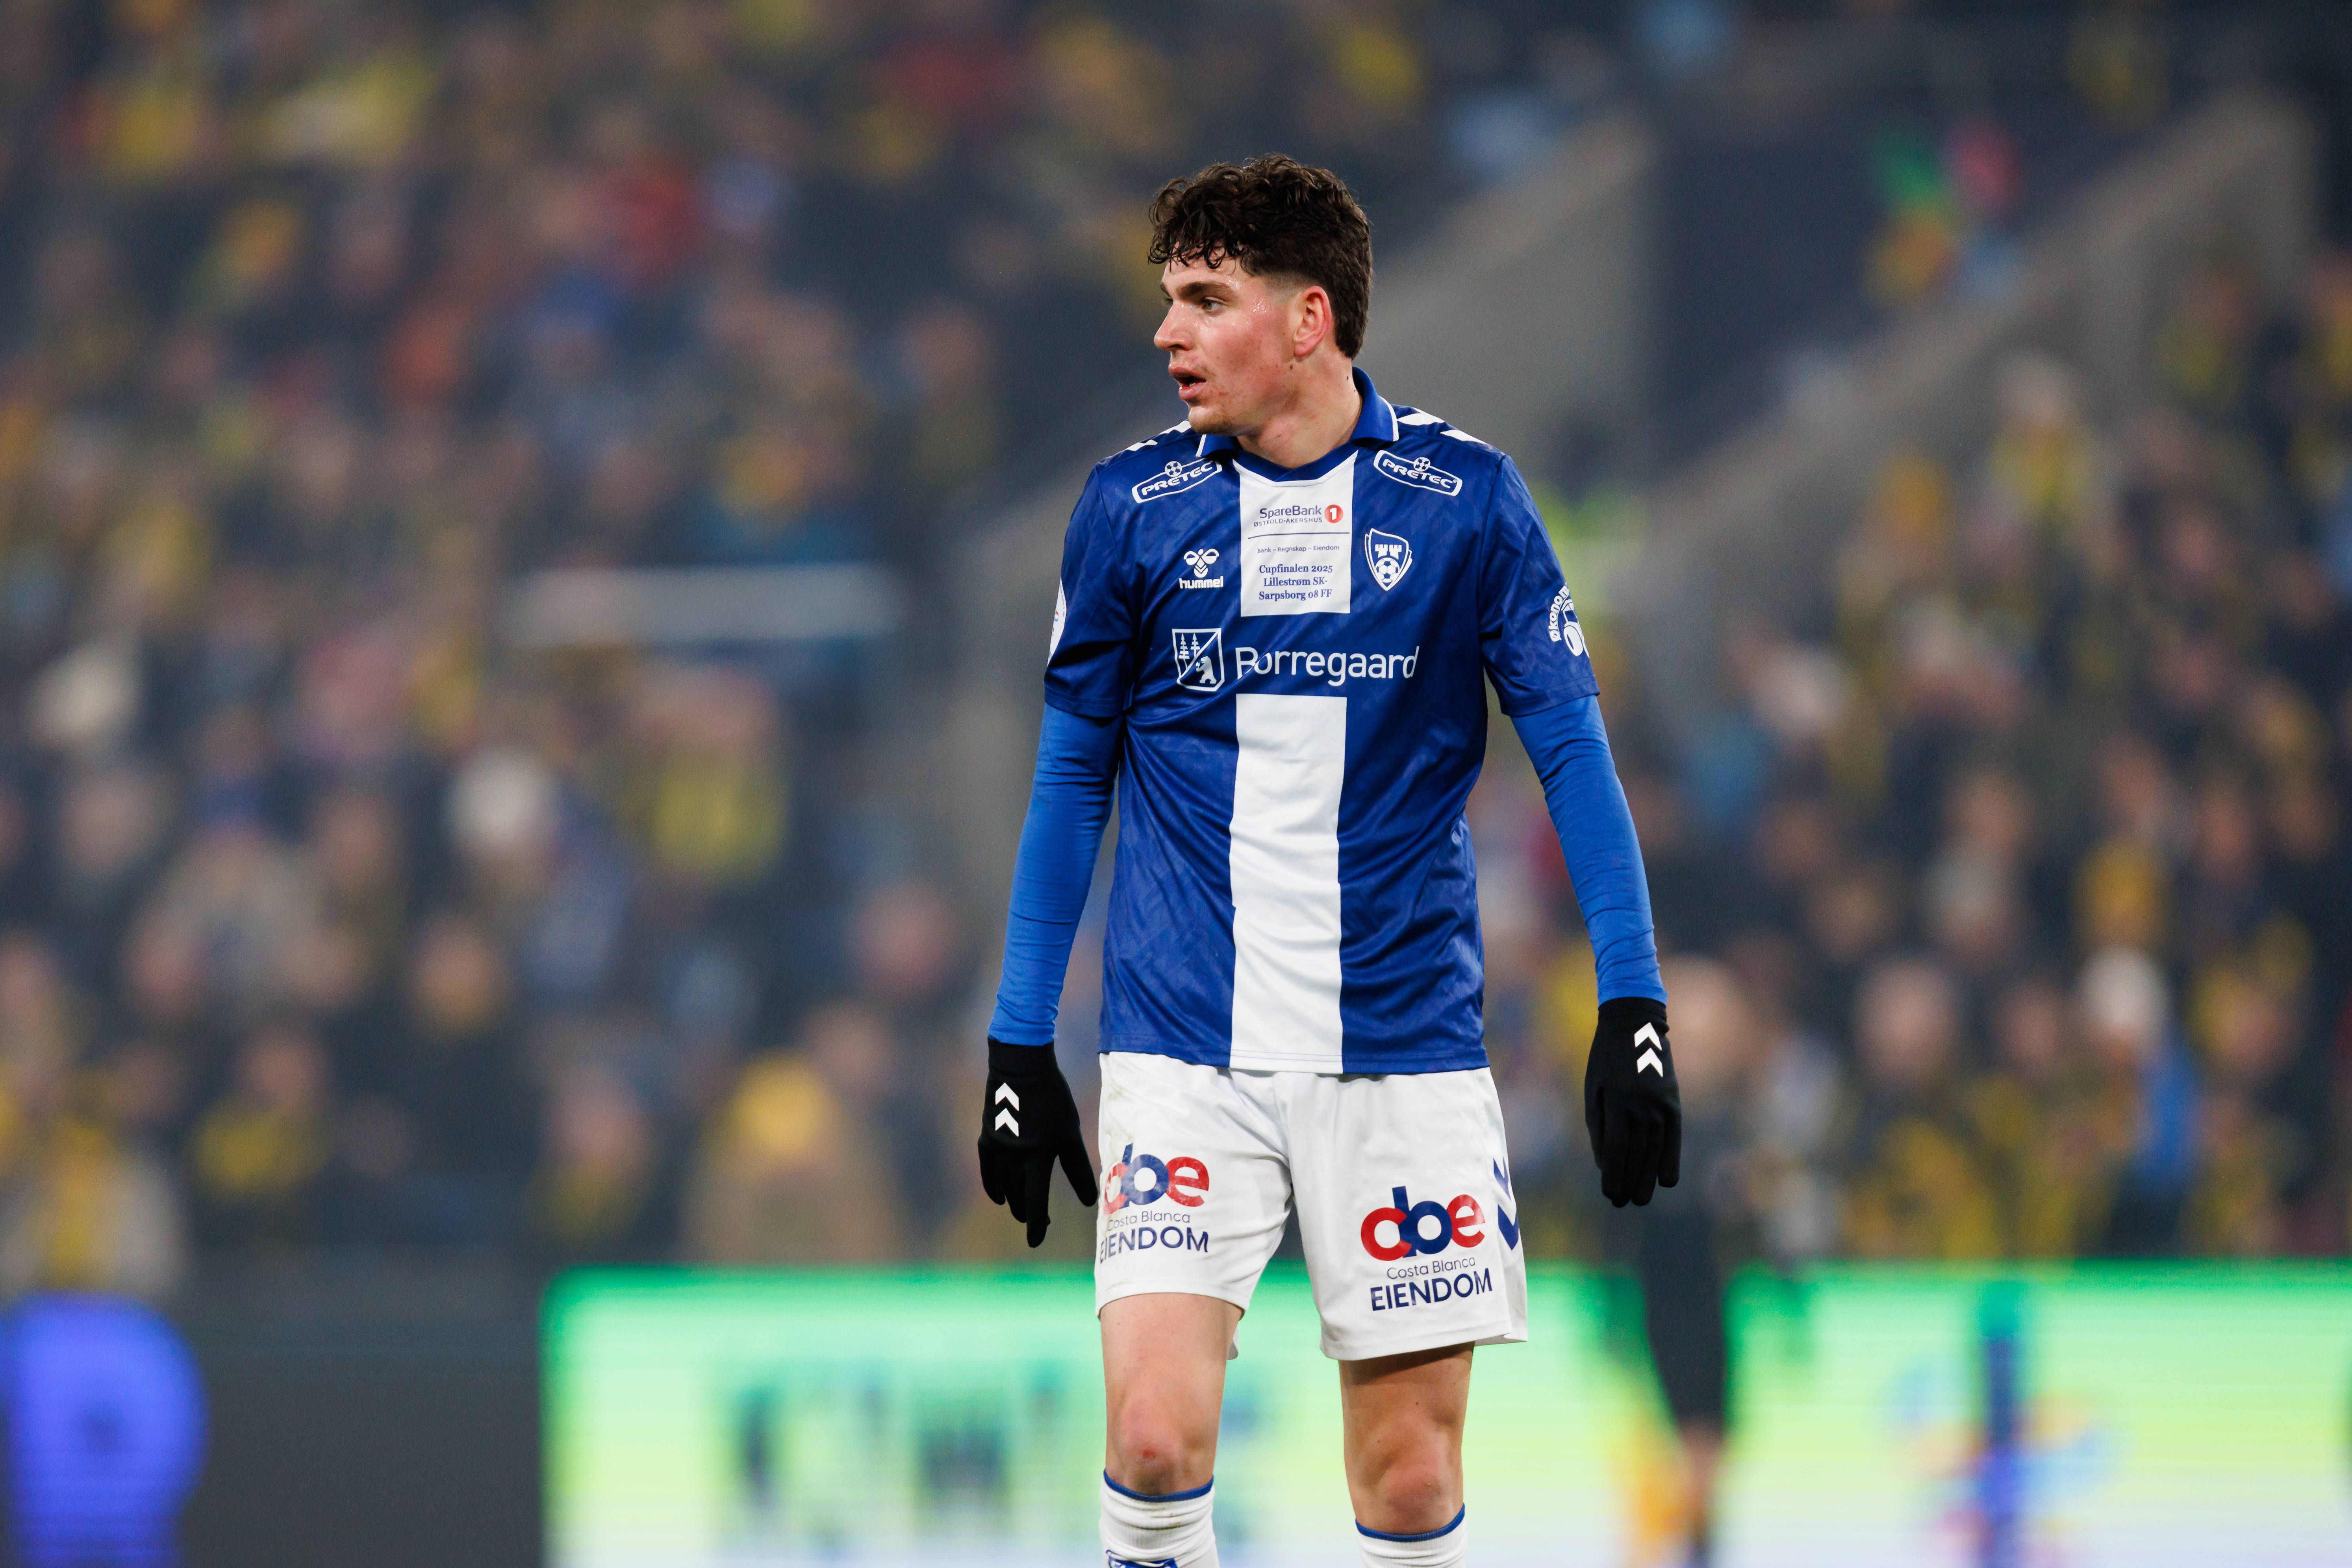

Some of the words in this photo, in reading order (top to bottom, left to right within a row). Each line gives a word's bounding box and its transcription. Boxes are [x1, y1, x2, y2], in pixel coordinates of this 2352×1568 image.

[1142, 462, 1213, 496] PRETEC
[1260, 505, 1322, 519] SpareBank
[1259, 563, 1309, 575] Cupfinalen
[1179, 575, 1224, 589] hummel
[1264, 577, 1310, 587] Lillestrøm
[1313, 576, 1328, 586] SK-
[1259, 590, 1306, 602] Sarpsborg
[1308, 589, 1318, 599] 08
[1321, 589, 1333, 597] FF
[1548, 583, 1570, 642] Økonom
[1107, 1215, 1137, 1231] Costa
[1141, 1210, 1190, 1223] Blanca
[1100, 1226, 1208, 1264] EIENDOM
[1387, 1265, 1429, 1279] Costa
[1432, 1257, 1475, 1273] Blanca
[1370, 1268, 1493, 1311] EIENDOM
